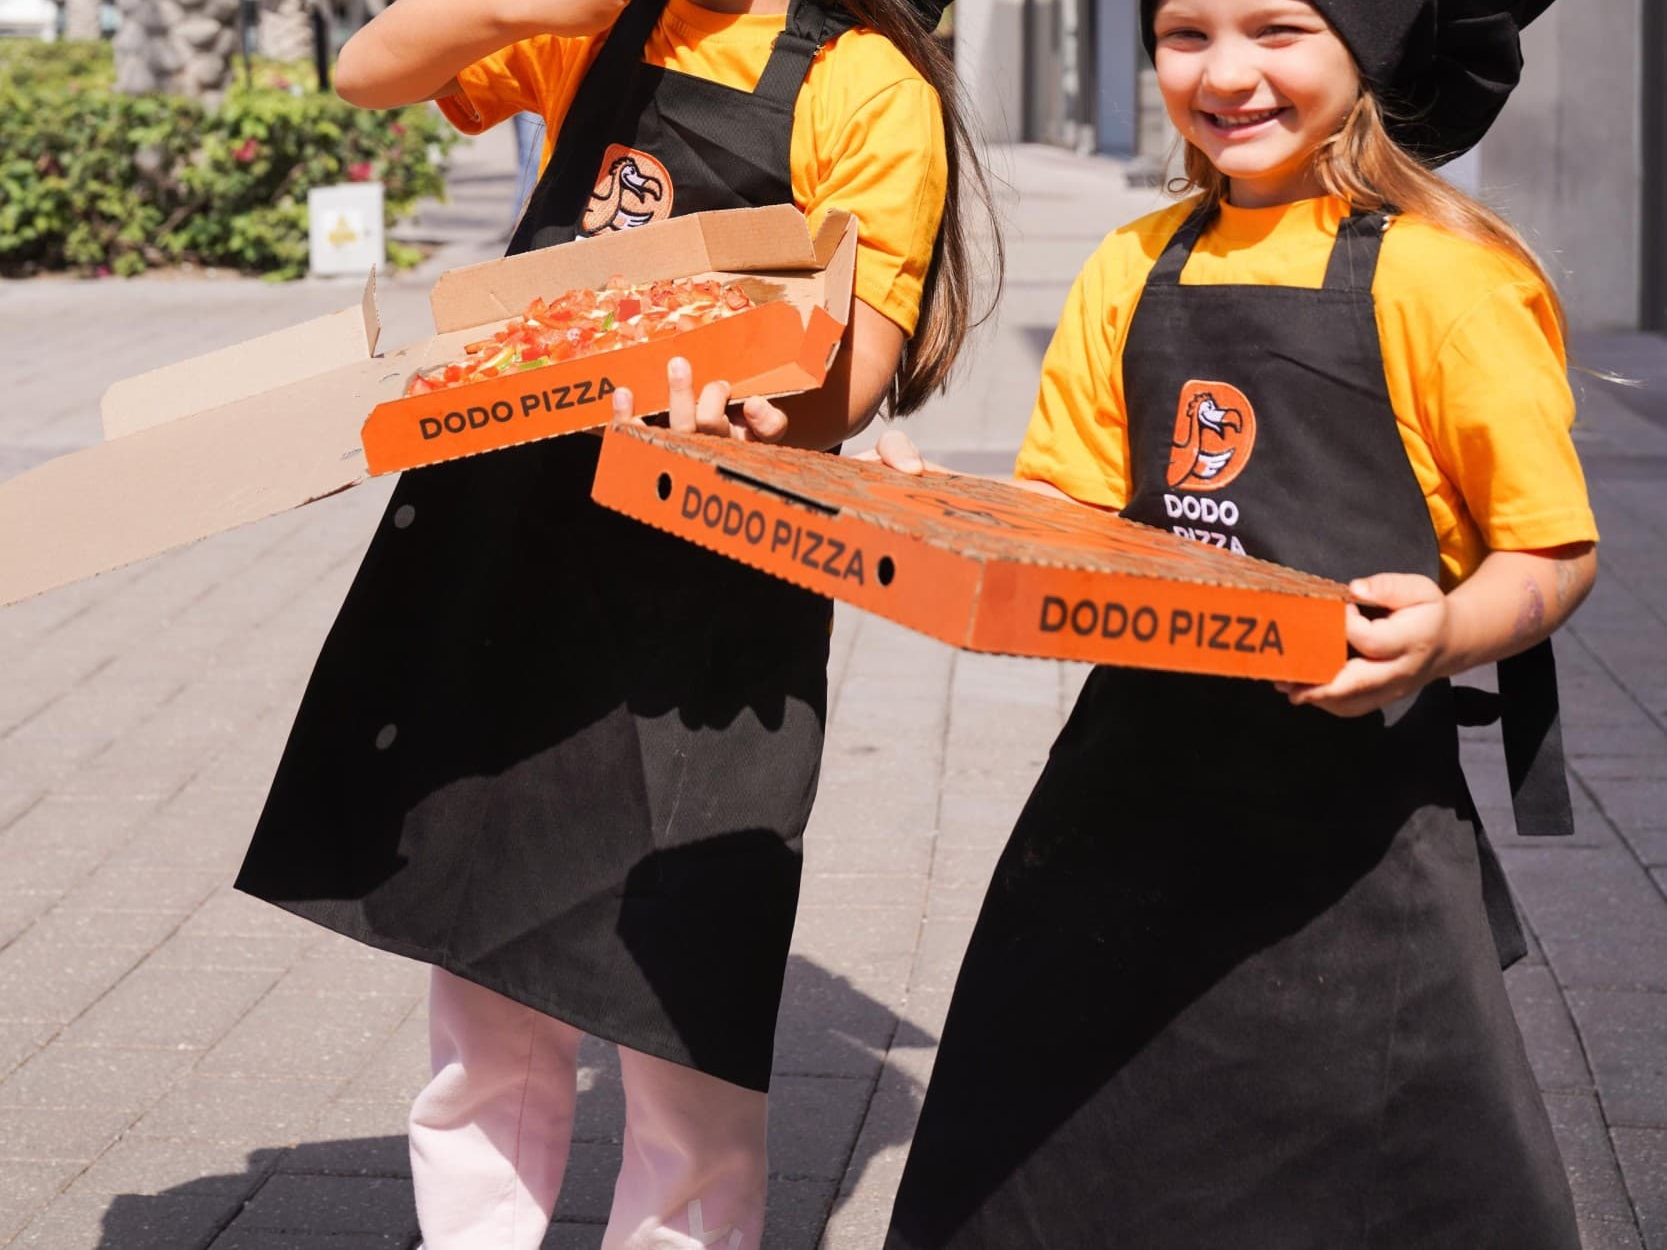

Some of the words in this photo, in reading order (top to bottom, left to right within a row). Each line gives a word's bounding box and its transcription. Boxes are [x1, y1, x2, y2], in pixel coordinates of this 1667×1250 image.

[419, 401, 514, 440] DODO
[520, 377, 616, 417] PIZZA
[681, 484, 766, 545] DODO
[770, 518, 865, 586] PIZZA
[1163, 493, 1239, 526] DODO
[1039, 595, 1159, 642] DODO
[1169, 609, 1285, 656] PIZZA
